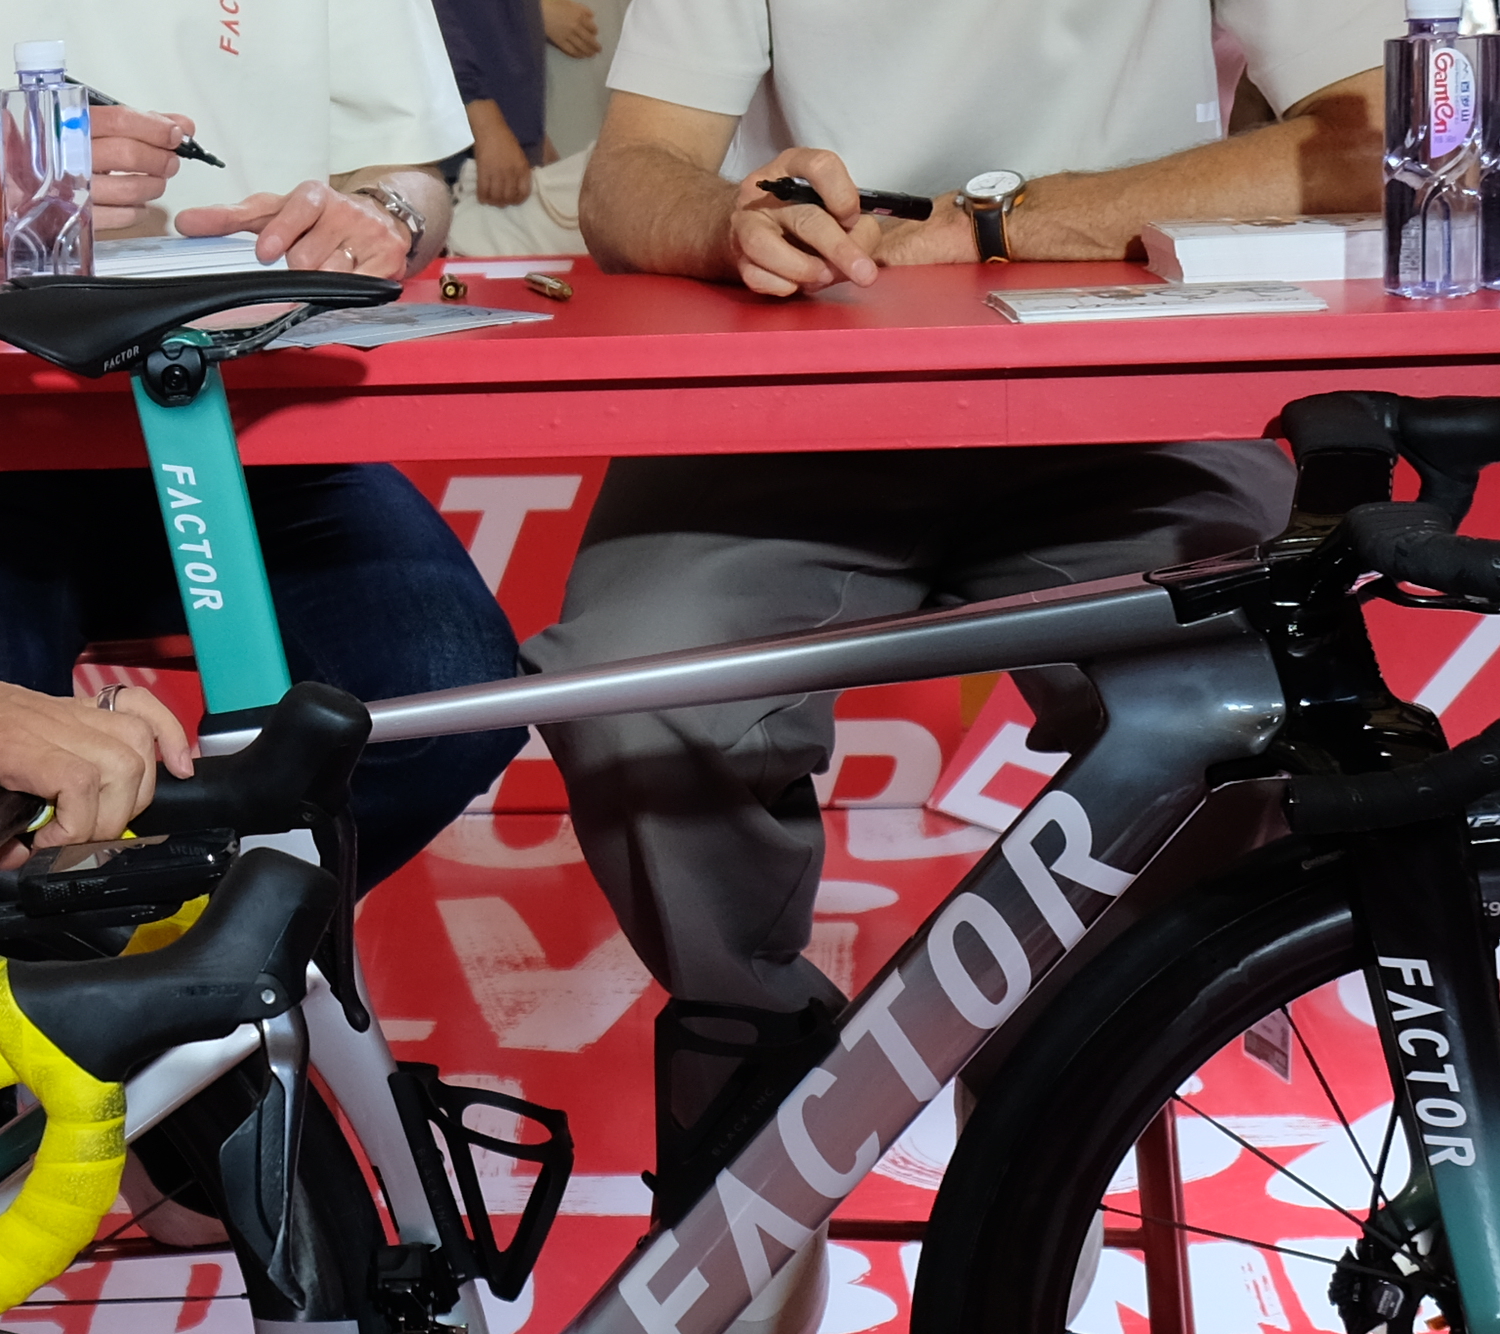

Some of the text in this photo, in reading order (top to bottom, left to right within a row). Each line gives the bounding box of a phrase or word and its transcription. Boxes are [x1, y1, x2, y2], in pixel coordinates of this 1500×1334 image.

[103, 345, 141, 372] FACTOR
[162, 463, 224, 611] FACTOR
[1377, 955, 1476, 1169] FACTOR
